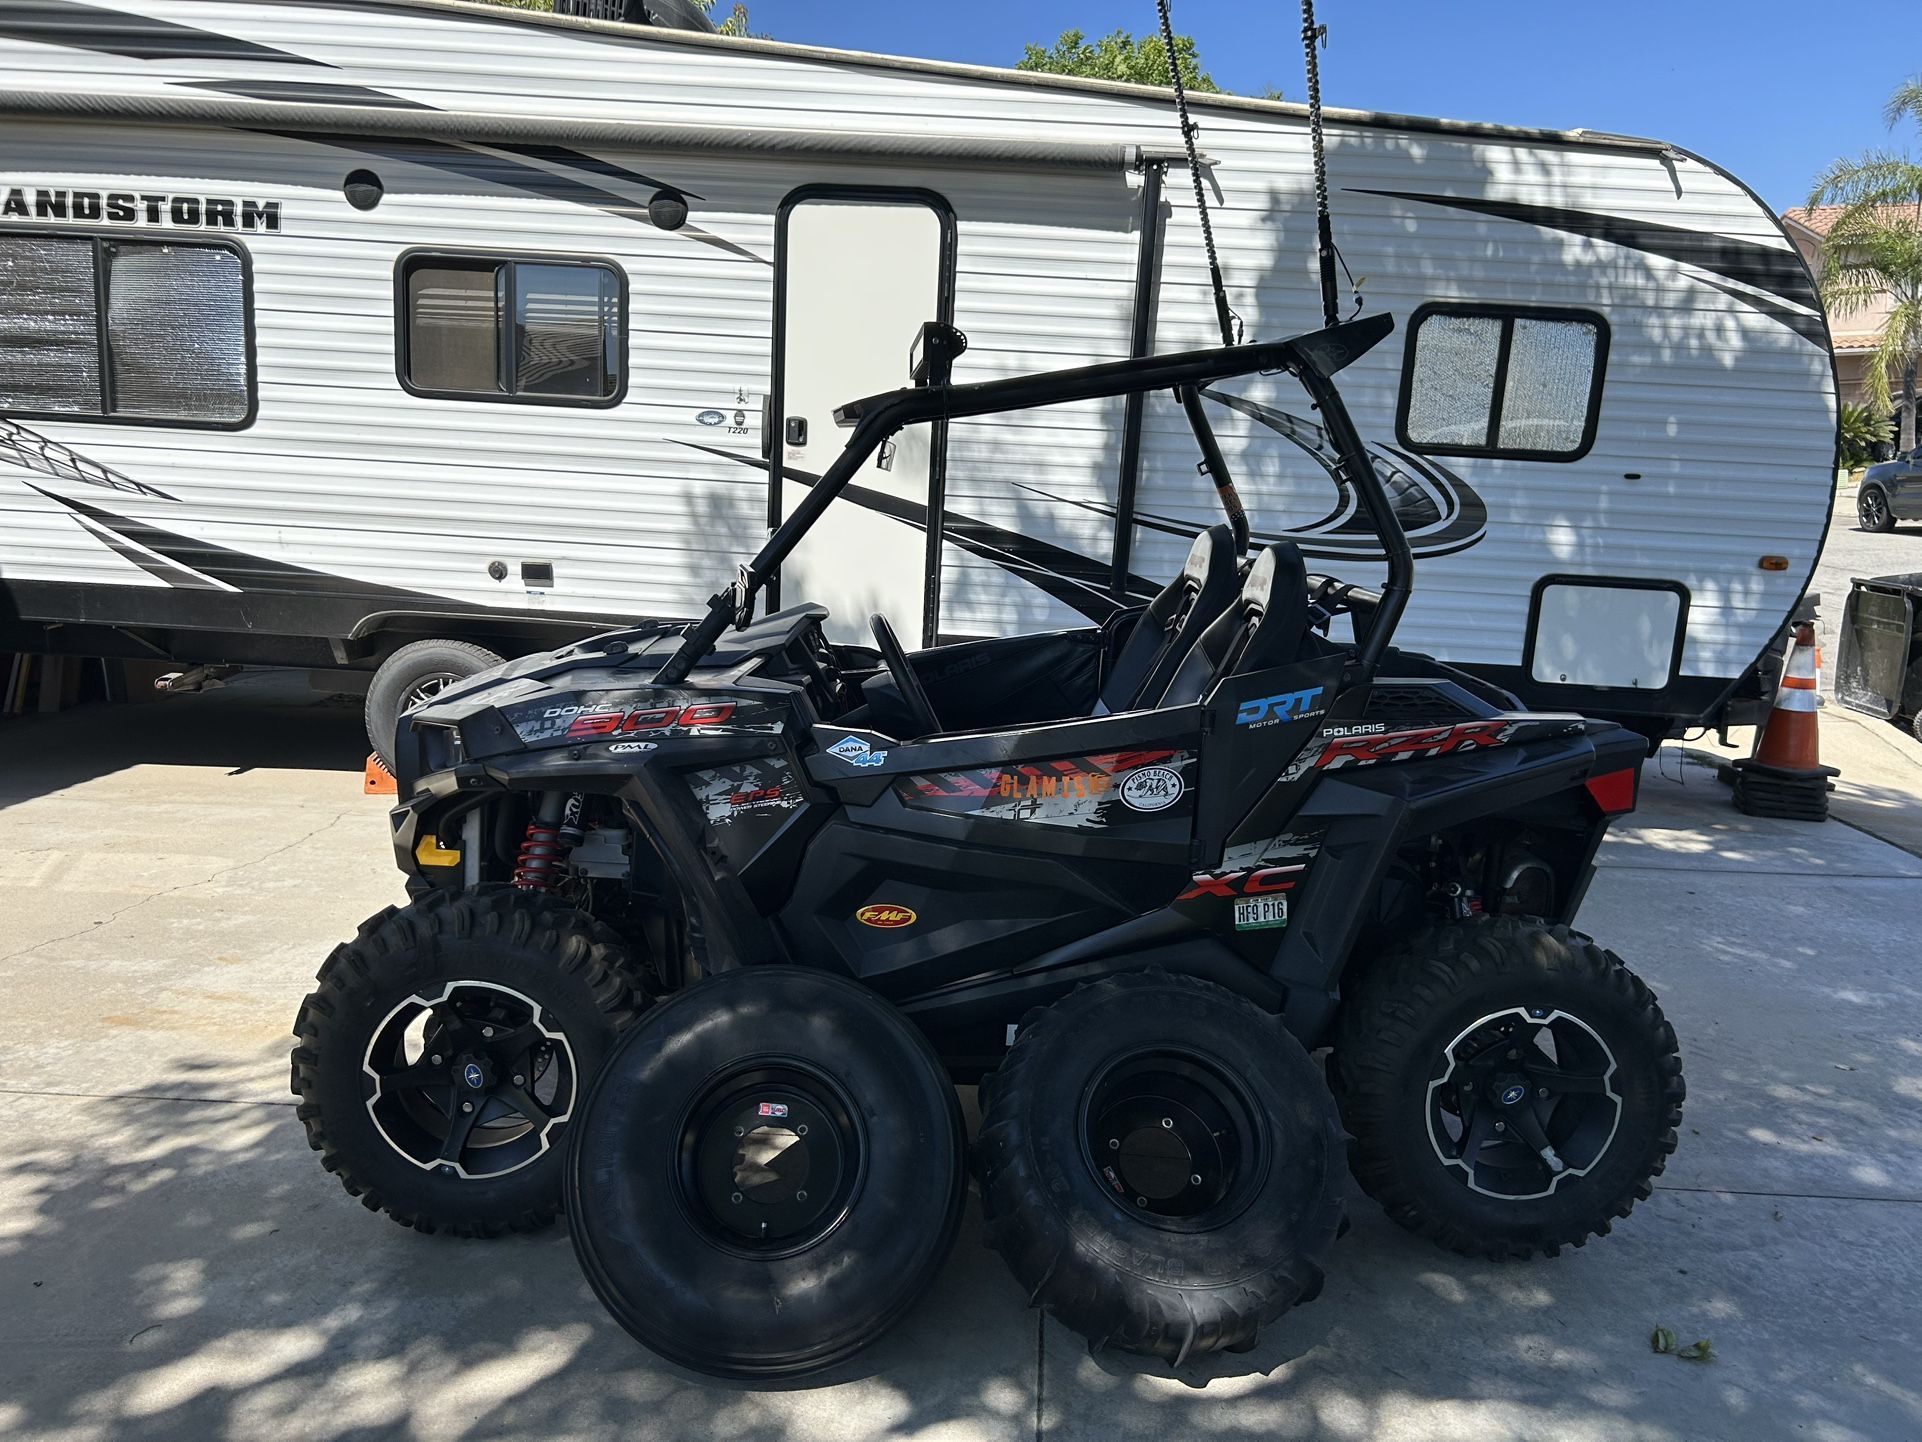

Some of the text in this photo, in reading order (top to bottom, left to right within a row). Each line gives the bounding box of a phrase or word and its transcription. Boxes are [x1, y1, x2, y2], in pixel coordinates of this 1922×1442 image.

[0, 187, 282, 233] ANDSTORM
[727, 426, 749, 435] T220
[1235, 686, 1324, 725] DRT
[543, 702, 737, 738] DOHC 900
[1248, 709, 1325, 729] MOTOR SPORTS
[1323, 723, 1385, 738] POLARIS
[613, 743, 654, 751] PML
[838, 745, 864, 753] DANA
[1314, 721, 1510, 769] RZR
[1131, 770, 1174, 784] PISMO BEACH
[730, 786, 782, 805] EPS
[1175, 863, 1306, 900] XC
[861, 910, 911, 920] FMF
[1238, 901, 1284, 923] HF9 P16
